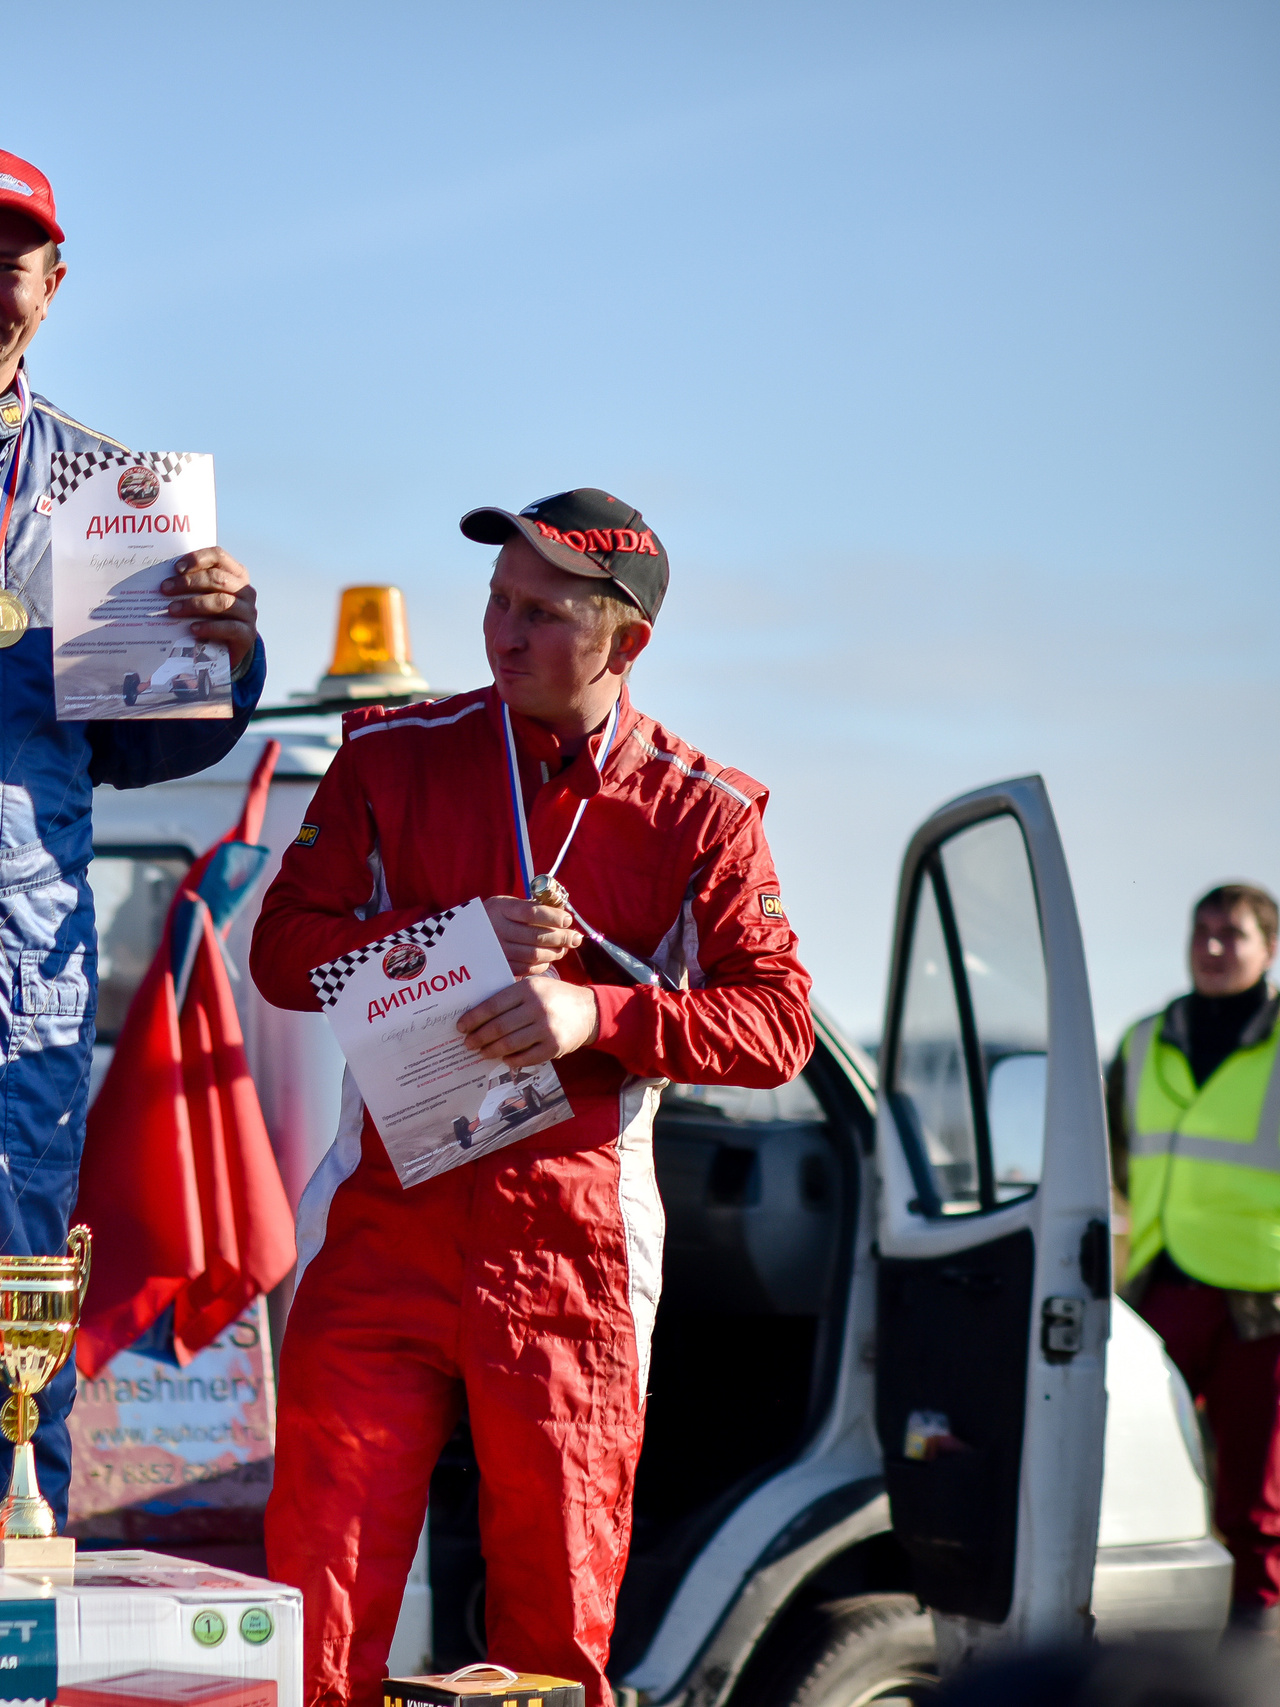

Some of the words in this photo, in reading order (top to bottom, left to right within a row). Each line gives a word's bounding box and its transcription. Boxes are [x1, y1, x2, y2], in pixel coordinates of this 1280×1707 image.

[86, 514, 191, 539] ДИПЛОМ
[533, 520, 659, 556] HONDA
[298, 827, 317, 842] MP
[367, 965, 471, 1023] ДИПЛОМ
[205, 1619, 211, 1634] 1
